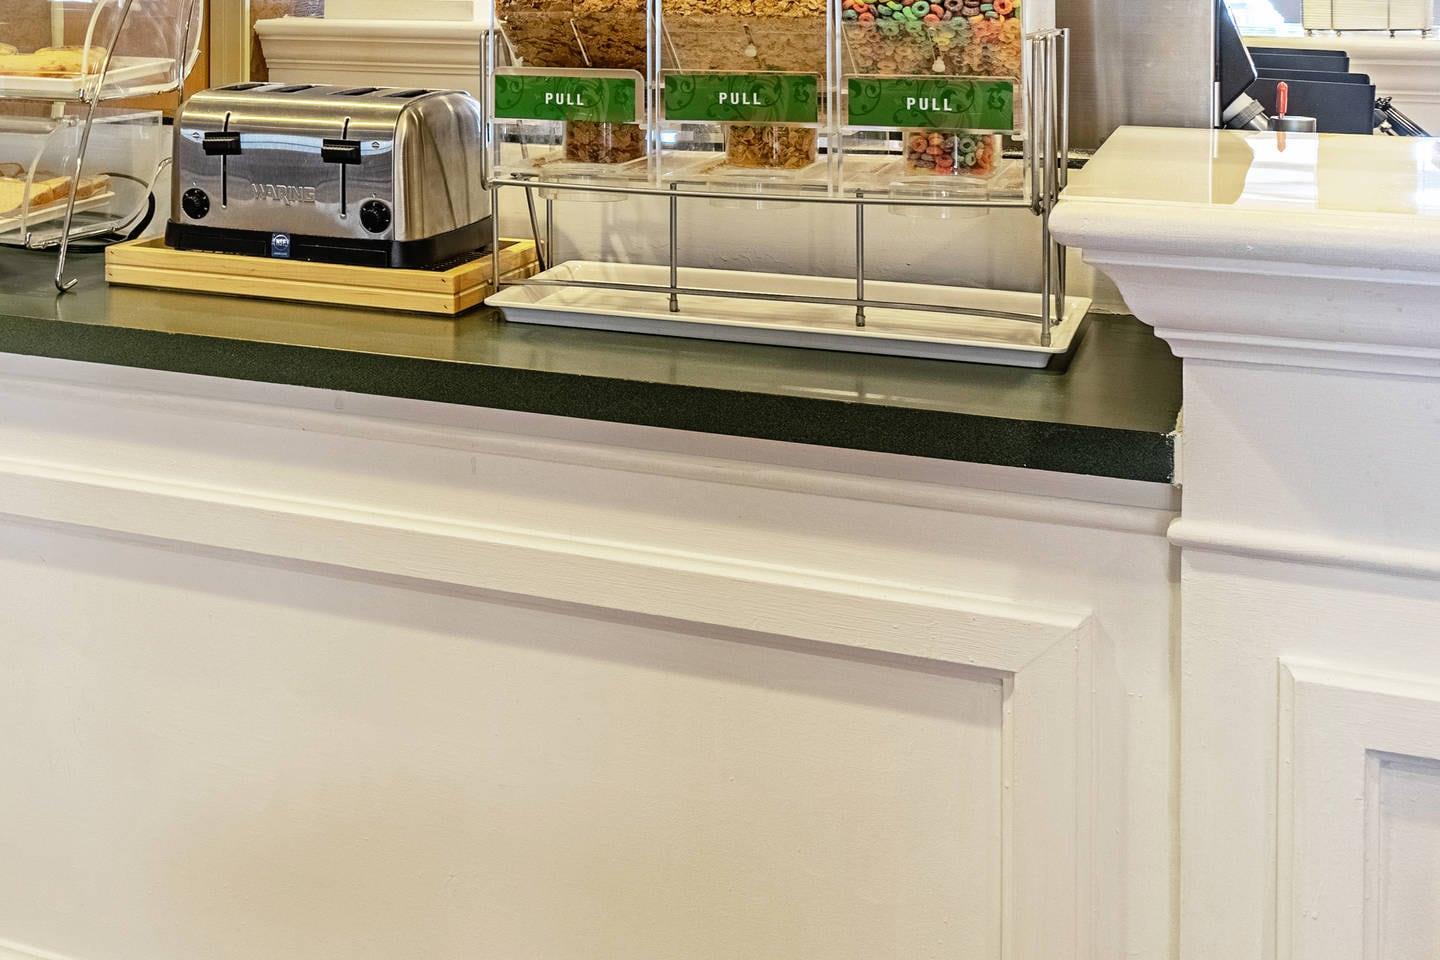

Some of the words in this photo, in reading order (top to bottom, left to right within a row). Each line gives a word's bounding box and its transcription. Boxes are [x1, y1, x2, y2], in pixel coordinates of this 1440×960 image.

[544, 92, 585, 106] PULL
[718, 92, 761, 105] PULL
[906, 97, 953, 112] PULL
[251, 183, 316, 207] WARING
